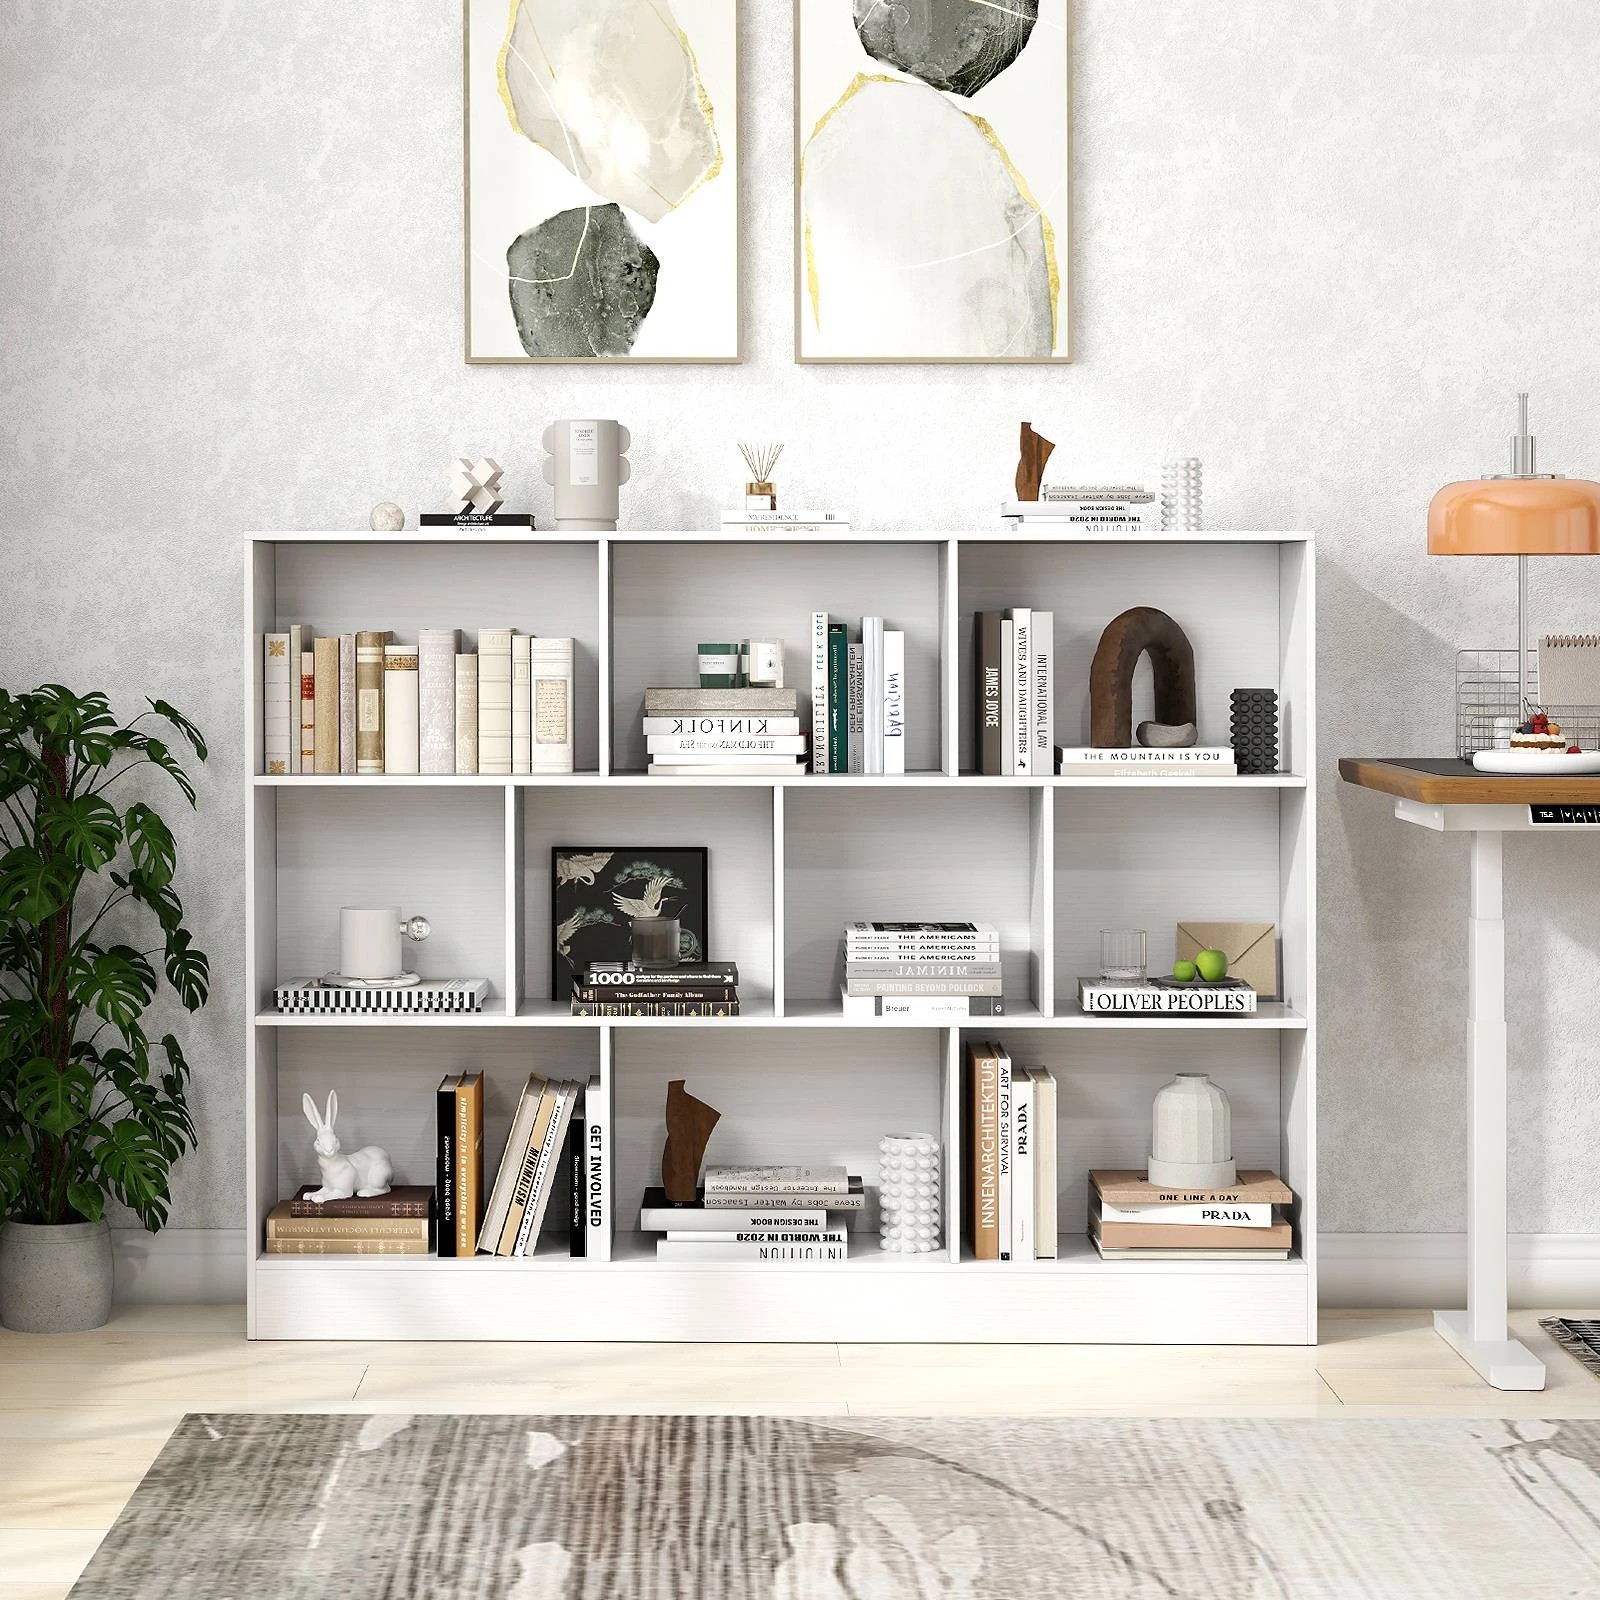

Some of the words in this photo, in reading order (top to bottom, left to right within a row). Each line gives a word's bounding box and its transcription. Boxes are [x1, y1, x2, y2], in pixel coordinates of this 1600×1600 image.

[1018, 627, 1027, 661] WIVES
[985, 666, 998, 697] JAMES
[1018, 663, 1027, 687] AND
[1037, 654, 1047, 726] INTERNATIONAL
[985, 700, 998, 727] JOYCE
[1018, 689, 1027, 753] DAUGHTERS
[1037, 730, 1047, 749] LAW
[589, 973, 635, 985] 1000
[876, 983, 913, 992] PAINTING
[915, 983, 946, 992] BEYOND
[949, 983, 984, 992] POLLOCK
[1097, 993, 1162, 1010] OLIVER
[1168, 993, 1245, 1010] PEOPLES
[1000, 1067, 1009, 1089] ART
[1000, 1094, 1009, 1118] FOR
[459, 1096, 468, 1143] simplicity
[1017, 1103, 1027, 1155] PRADA
[590, 1125, 602, 1151] GET
[981, 1059, 995, 1228] INNENARCHITEKTUR
[1000, 1122, 1009, 1176] SURVIVAL
[514, 1146, 540, 1207] MINIMALISM
[590, 1156, 602, 1227] INVOLVED
[791, 1199, 803, 1207] by
[1202, 1210, 1251, 1220] PRADA
[737, 1233, 764, 1242] 2020
[767, 1233, 779, 1242] IN
[781, 1233, 819, 1242] WORLD
[822, 1233, 842, 1242] THE
